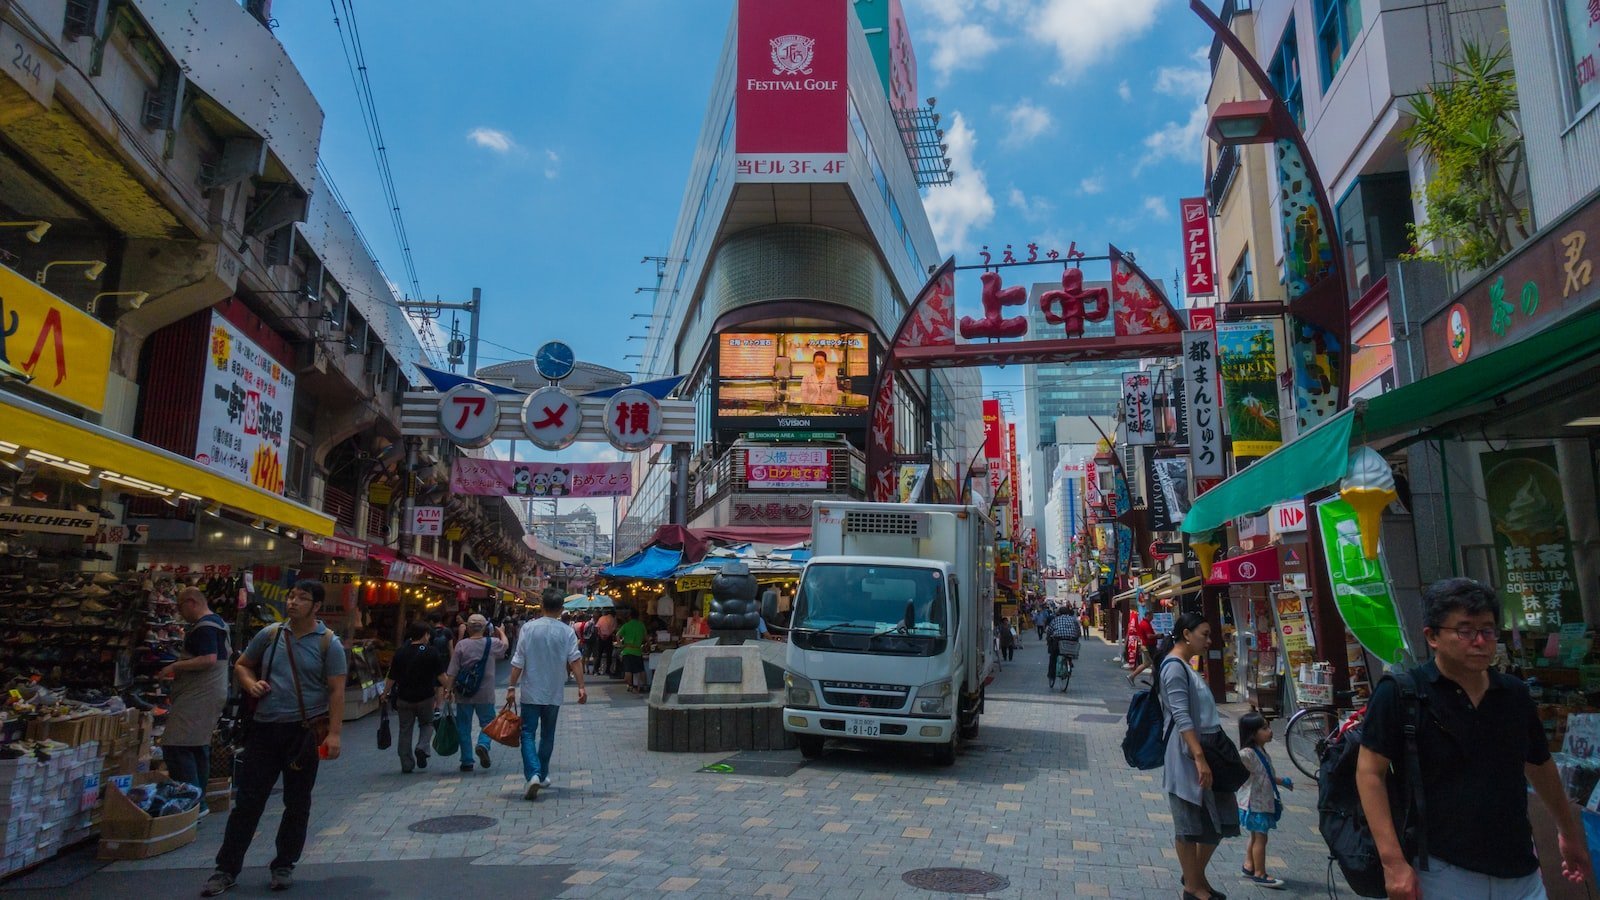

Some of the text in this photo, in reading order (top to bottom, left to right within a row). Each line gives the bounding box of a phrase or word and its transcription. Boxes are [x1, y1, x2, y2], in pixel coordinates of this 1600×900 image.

[13, 43, 42, 86] 244
[747, 78, 838, 91] FESTIVAL GOLF
[960, 267, 1110, 338] 上中
[1188, 341, 1215, 465] 都まんじゅう
[453, 396, 650, 435] アメ横
[0, 512, 94, 529] SKECHERS
[417, 510, 441, 518] ATM
[1280, 508, 1295, 527] IN
[1503, 543, 1568, 571] 抹茶
[1508, 571, 1570, 582] GREEN TEA
[1506, 582, 1574, 594] SOFTCREAM
[823, 681, 907, 691] CANTER
[853, 725, 879, 737] 81-02
